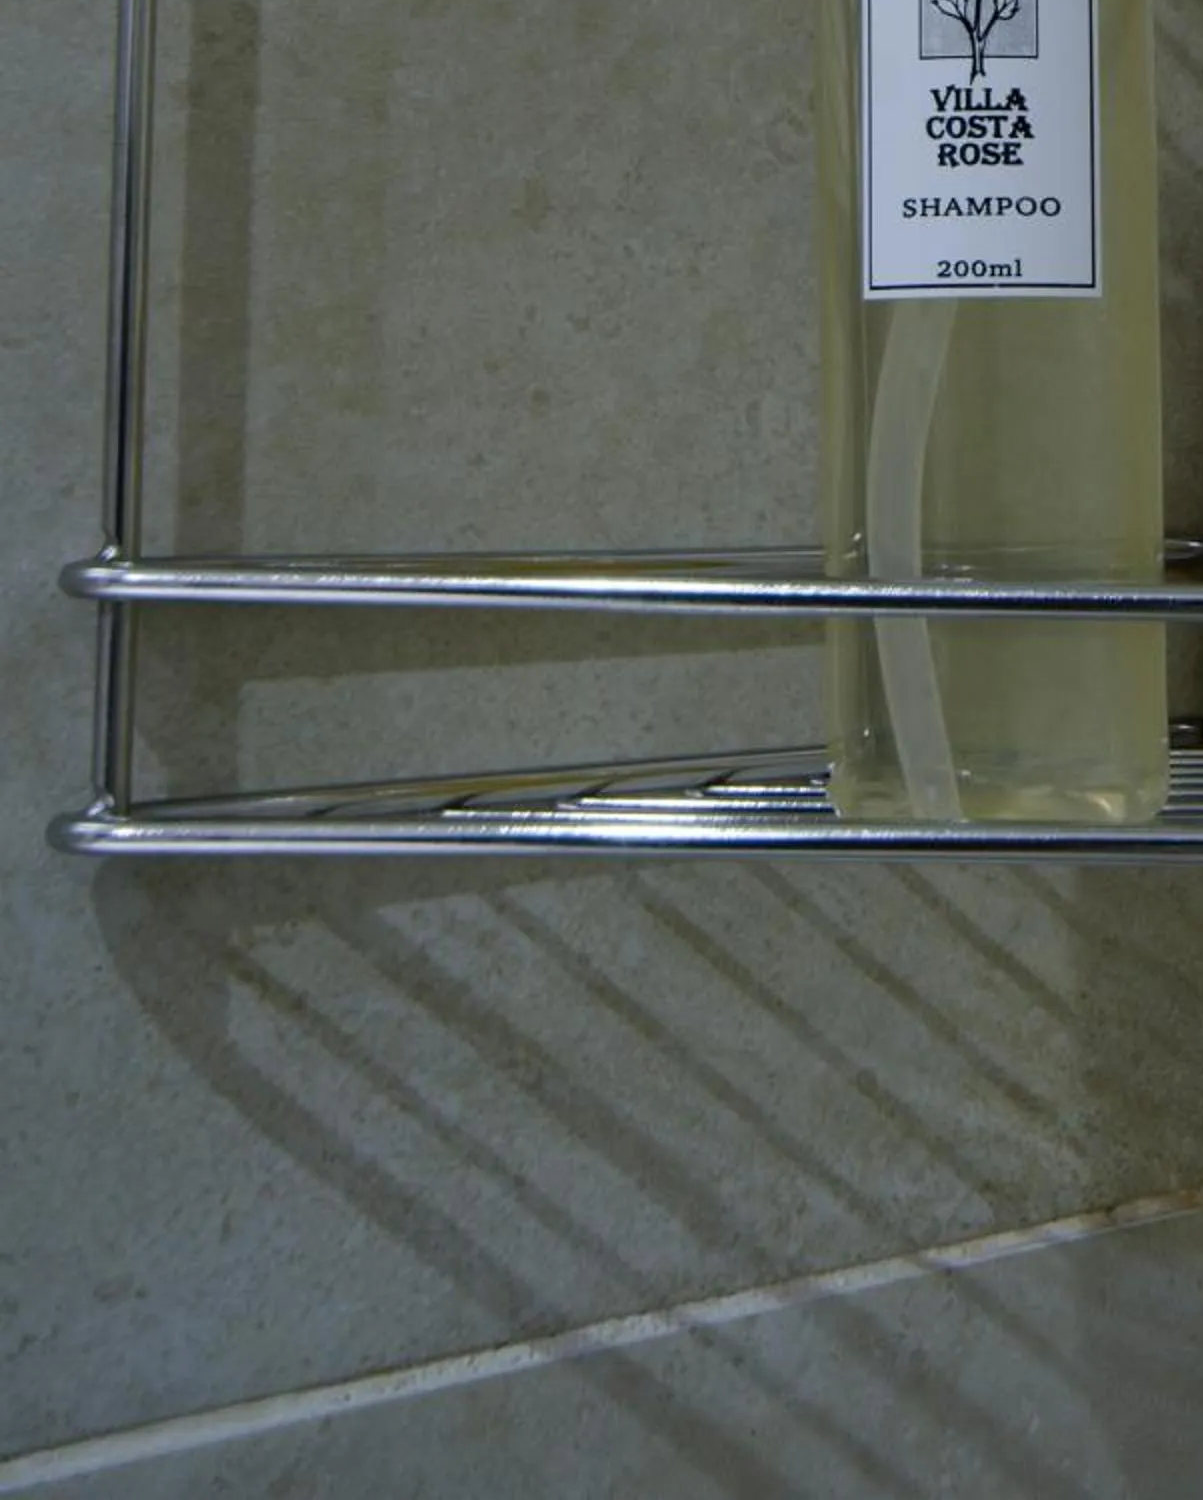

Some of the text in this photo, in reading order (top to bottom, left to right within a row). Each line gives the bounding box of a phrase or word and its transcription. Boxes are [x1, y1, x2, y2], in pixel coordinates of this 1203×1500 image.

[930, 85, 1029, 113] VILLA
[925, 114, 1034, 140] COSTA
[937, 141, 1024, 167] ROSE
[902, 196, 1062, 219] SHAMPOO
[936, 258, 1023, 278] 200ml
